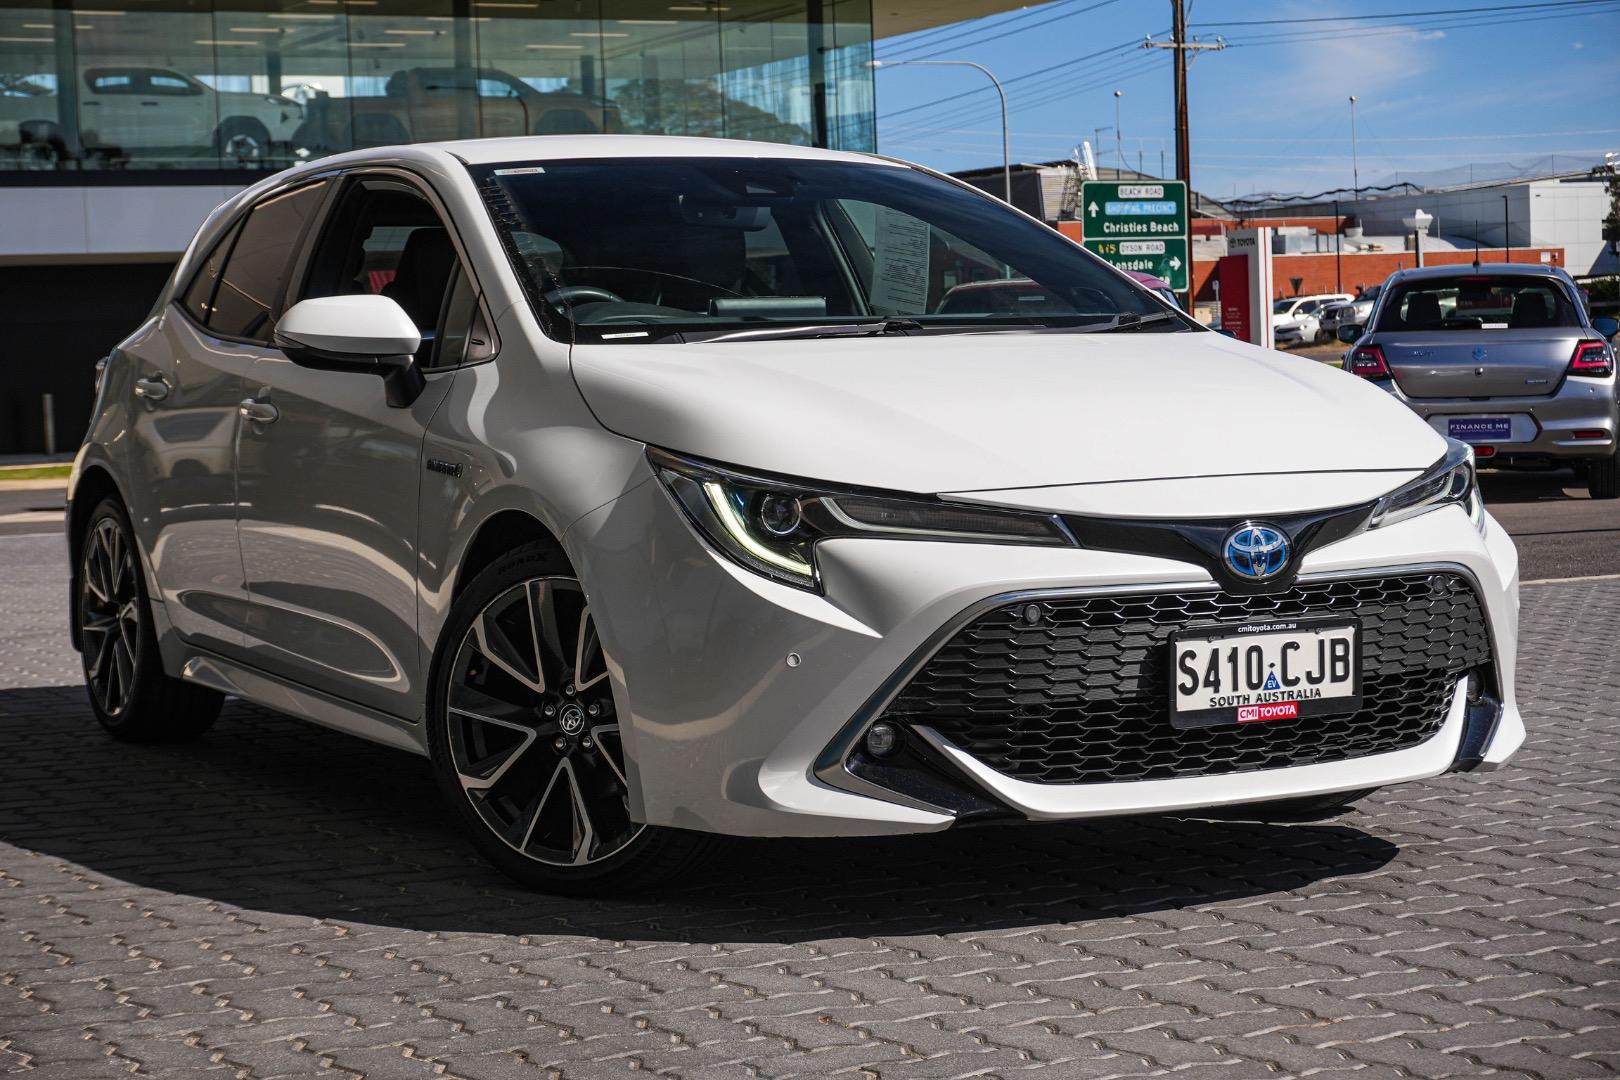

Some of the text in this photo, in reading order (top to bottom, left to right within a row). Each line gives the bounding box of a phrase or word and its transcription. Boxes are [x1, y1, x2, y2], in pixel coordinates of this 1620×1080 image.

[1120, 187, 1162, 196] BEACH ROAD
[1103, 221, 1179, 233] Christies Beach
[1237, 238, 1255, 247] TOYOTA
[1121, 245, 1142, 253] DYSON
[1145, 243, 1164, 252] ROAD
[1238, 623, 1297, 633] cmitoyota.com.au
[1267, 680, 1277, 689] EV
[1209, 687, 1322, 708] SOUTH AUSTRALIA
[1239, 704, 1296, 719] CMI TOYOTA
